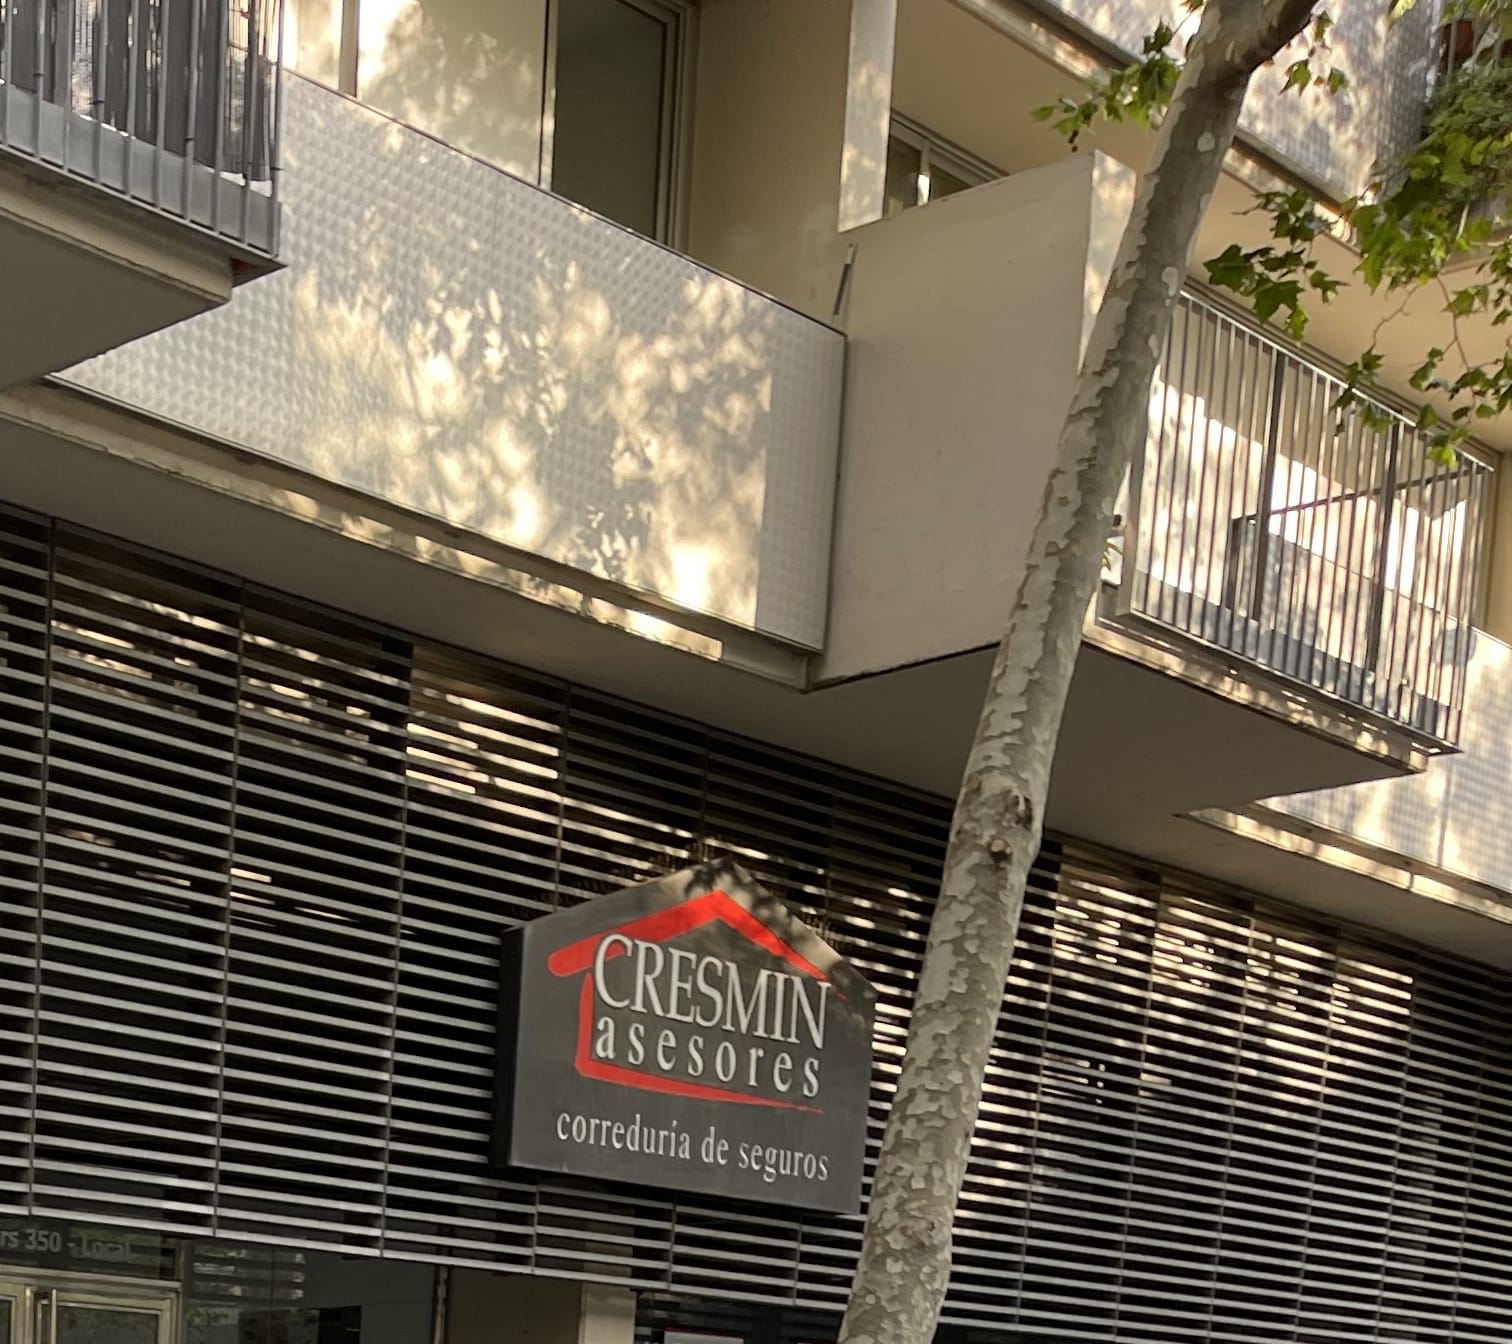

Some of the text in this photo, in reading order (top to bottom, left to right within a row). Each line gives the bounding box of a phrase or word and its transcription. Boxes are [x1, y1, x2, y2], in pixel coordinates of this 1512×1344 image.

[594, 933, 832, 1050] CRESMIN
[595, 1014, 821, 1098] asesores
[556, 1111, 830, 1184] correduría de seguros
[24, 1228, 62, 1254] 350
